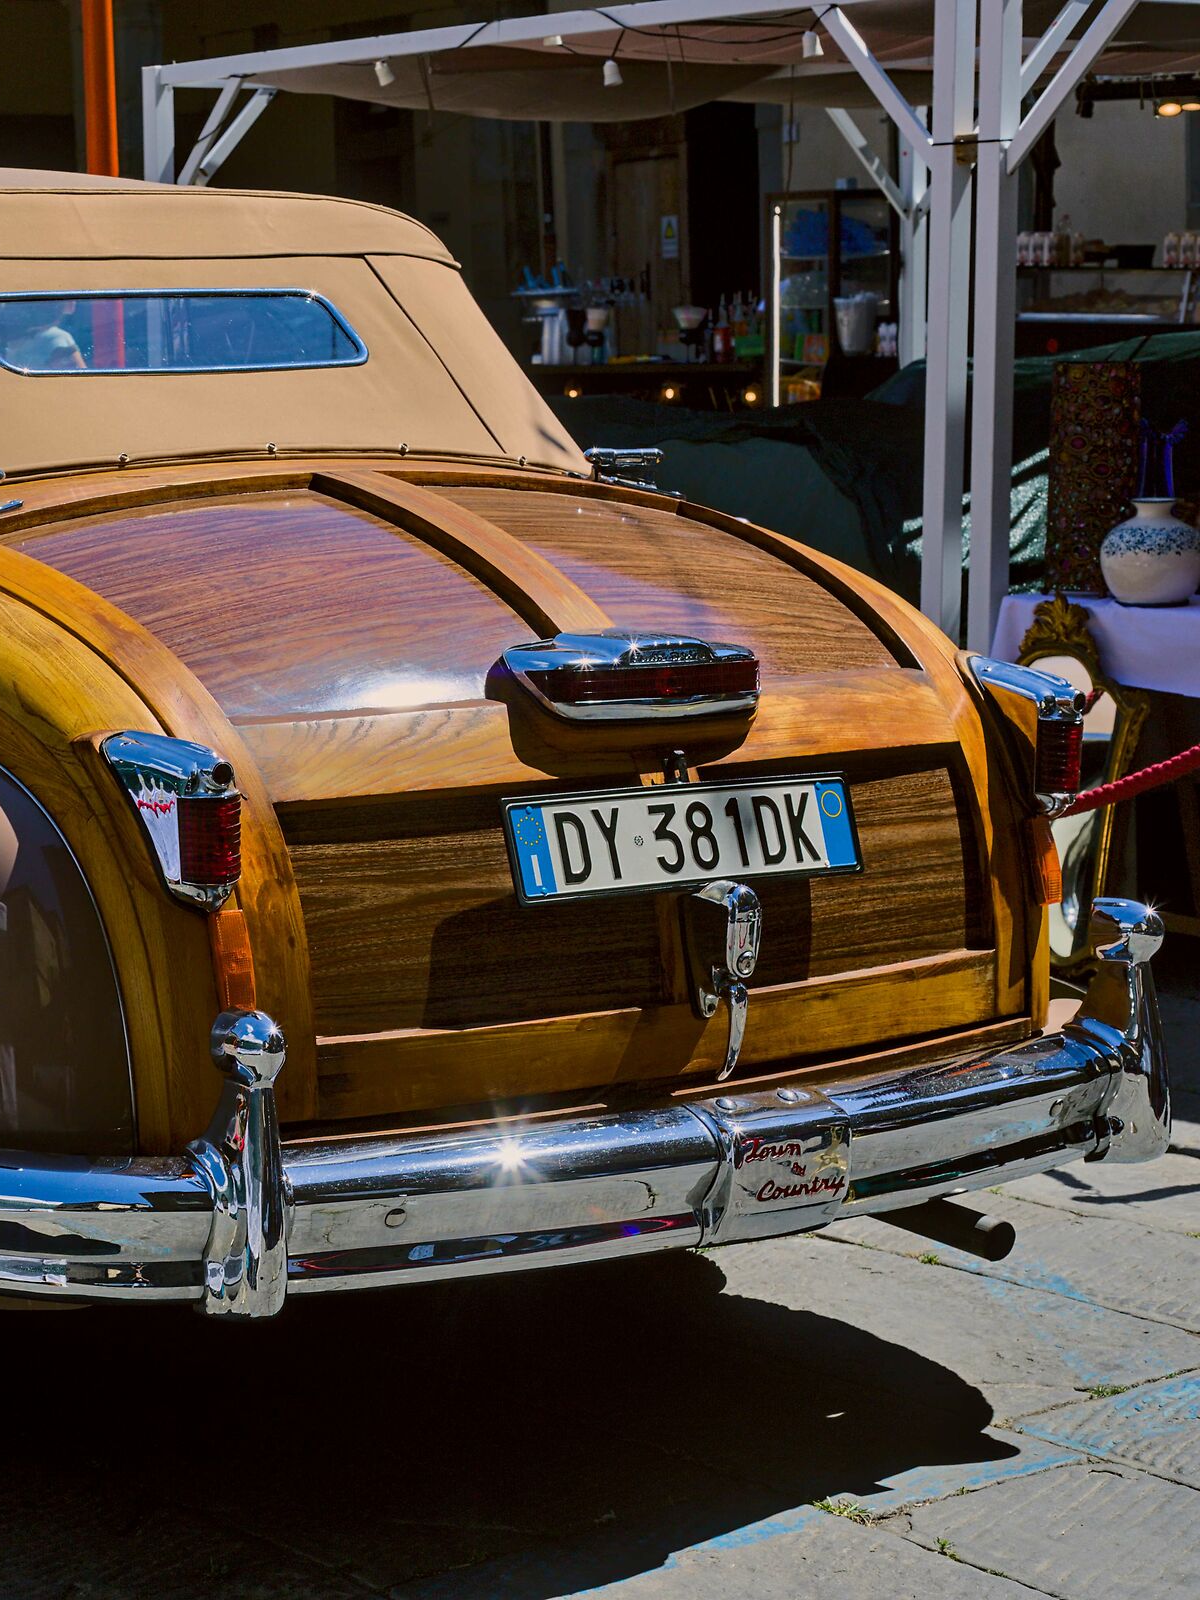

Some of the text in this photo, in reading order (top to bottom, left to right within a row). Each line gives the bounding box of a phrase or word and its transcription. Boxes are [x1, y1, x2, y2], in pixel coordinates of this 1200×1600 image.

[553, 791, 822, 885] DY 381DK
[736, 1137, 802, 1168] Town
[757, 1175, 846, 1202] Country
